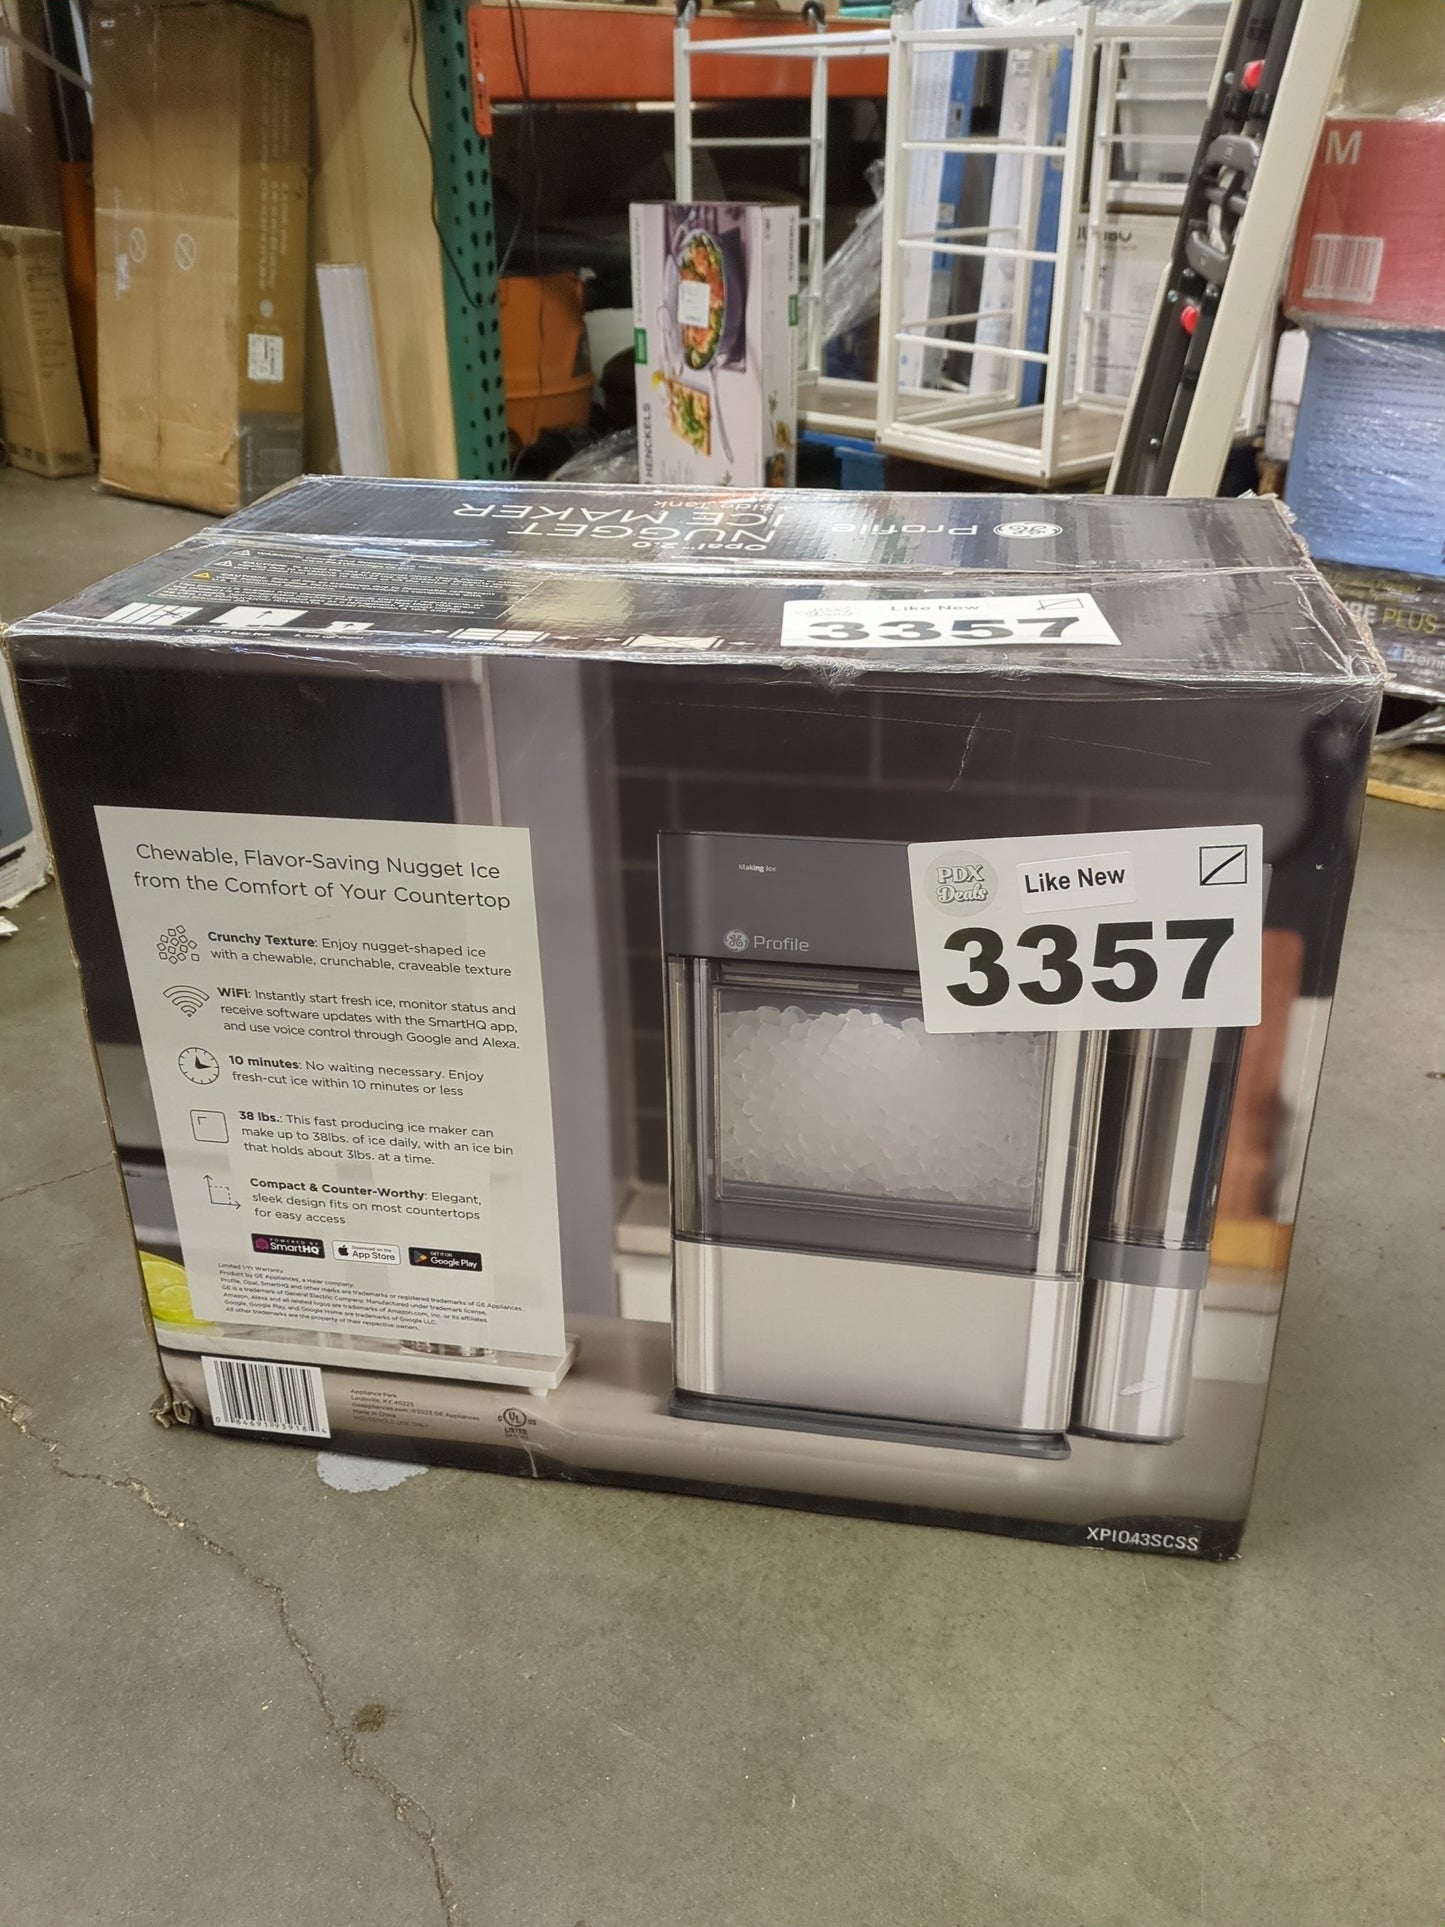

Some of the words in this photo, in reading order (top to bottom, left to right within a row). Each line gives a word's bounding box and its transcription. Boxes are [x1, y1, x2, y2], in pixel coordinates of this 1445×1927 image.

[1325, 130, 1363, 165] M
[642, 403, 653, 478] HENCKELS
[452, 503, 670, 524] MAKER
[653, 500, 712, 510] Tank
[685, 511, 785, 527] ICE
[831, 523, 977, 536] Profile
[507, 521, 777, 543] NUGGET
[938, 603, 980, 611] New
[807, 617, 1080, 641] 3357
[1382, 606, 1438, 635] PLUS
[137, 844, 239, 866] Chewable,
[244, 850, 380, 874] Flavor-Saving
[387, 858, 464, 878] Nugget
[471, 862, 500, 878] Ice
[738, 863, 765, 873] Making
[936, 865, 986, 885] PDX
[1024, 874, 1071, 894] Like
[1077, 868, 1127, 889] New
[134, 872, 181, 888] from
[186, 875, 219, 891] the
[225, 878, 309, 896] Comfort
[315, 883, 335, 897] of
[340, 884, 387, 900] Your
[394, 887, 511, 910] Countertop
[935, 884, 989, 904] Deals
[208, 932, 262, 946] Crunchy
[264, 935, 318, 947] Texture:
[322, 938, 358, 951] Enjoy
[363, 943, 463, 956] nugget-shaped
[467, 947, 486, 957] ice
[754, 935, 810, 952] Profile
[210, 949, 238, 959] with
[253, 951, 317, 966] chewable,
[320, 957, 395, 970] crunchable,
[398, 962, 462, 973] craveable
[465, 964, 512, 976] texture
[943, 917, 1235, 1007] 3357
[217, 987, 252, 998] WiFi:
[255, 990, 306, 1004] Instantly
[310, 994, 339, 1004] start
[341, 995, 372, 1006] fresh
[375, 997, 396, 1008] ice,
[399, 1000, 448, 1010] monitor
[451, 1002, 489, 1013] status
[492, 1006, 517, 1015] and
[221, 1005, 264, 1016] receive
[267, 1008, 320, 1019] software
[323, 1012, 373, 1022] updates
[375, 1014, 402, 1024] with
[405, 1016, 426, 1026] the
[428, 1017, 487, 1030] SmartHQ
[490, 1023, 518, 1033] app,
[224, 1022, 247, 1031] and
[249, 1025, 271, 1033] use
[273, 1025, 306, 1035] voice
[308, 1028, 352, 1038] control
[354, 1029, 404, 1042] through
[406, 1032, 452, 1045] Google
[455, 1036, 479, 1046] and
[482, 1037, 520, 1048] Alexa.
[229, 1056, 244, 1065] 10
[248, 1057, 303, 1069] minutes:
[306, 1061, 325, 1071] No
[328, 1063, 375, 1075] waiting
[379, 1067, 445, 1080] necessary.
[449, 1070, 484, 1082] Enjoy
[232, 1071, 288, 1084] fresh-cut
[290, 1076, 309, 1086] ice
[312, 1077, 350, 1088] within
[352, 1080, 367, 1089] 10
[370, 1081, 420, 1093] minutes
[440, 1085, 464, 1096] less
[239, 1111, 255, 1120] 38
[258, 1112, 284, 1123] lbs.:
[286, 1115, 311, 1125] This
[314, 1116, 338, 1127] fast
[341, 1120, 404, 1133] producing
[408, 1123, 426, 1132] ice
[429, 1125, 468, 1135] maker
[471, 1129, 494, 1137] can
[242, 1128, 275, 1137] make
[277, 1132, 294, 1140] up
[296, 1131, 310, 1140] to
[312, 1132, 349, 1143] 38lbs.
[352, 1135, 365, 1144] of
[368, 1135, 387, 1145] ice
[389, 1137, 421, 1149] daily,
[424, 1140, 451, 1150] with
[473, 1143, 491, 1153] ice
[494, 1144, 514, 1154] bin
[244, 1142, 269, 1152] that
[271, 1144, 305, 1155] holds
[307, 1147, 344, 1158] about
[346, 1150, 375, 1160] 3lbs.
[378, 1153, 391, 1161] at
[404, 1154, 435, 1164] time.
[250, 1178, 307, 1190] Compact
[310, 1183, 319, 1192] &
[322, 1184, 428, 1201] Counter-Worthy:
[432, 1192, 482, 1205] Elegant,
[253, 1193, 284, 1204] sleek
[286, 1196, 327, 1208] design
[330, 1199, 349, 1209] fits
[371, 1204, 403, 1213] most
[406, 1207, 481, 1220] countertops
[255, 1208, 272, 1217] for
[275, 1212, 303, 1221] easy
[306, 1214, 346, 1224] access
[270, 1241, 321, 1256] SmartHQ
[352, 1250, 370, 1260] App
[372, 1252, 396, 1261] Store
[430, 1256, 459, 1268] Google
[460, 1259, 478, 1269] Play
